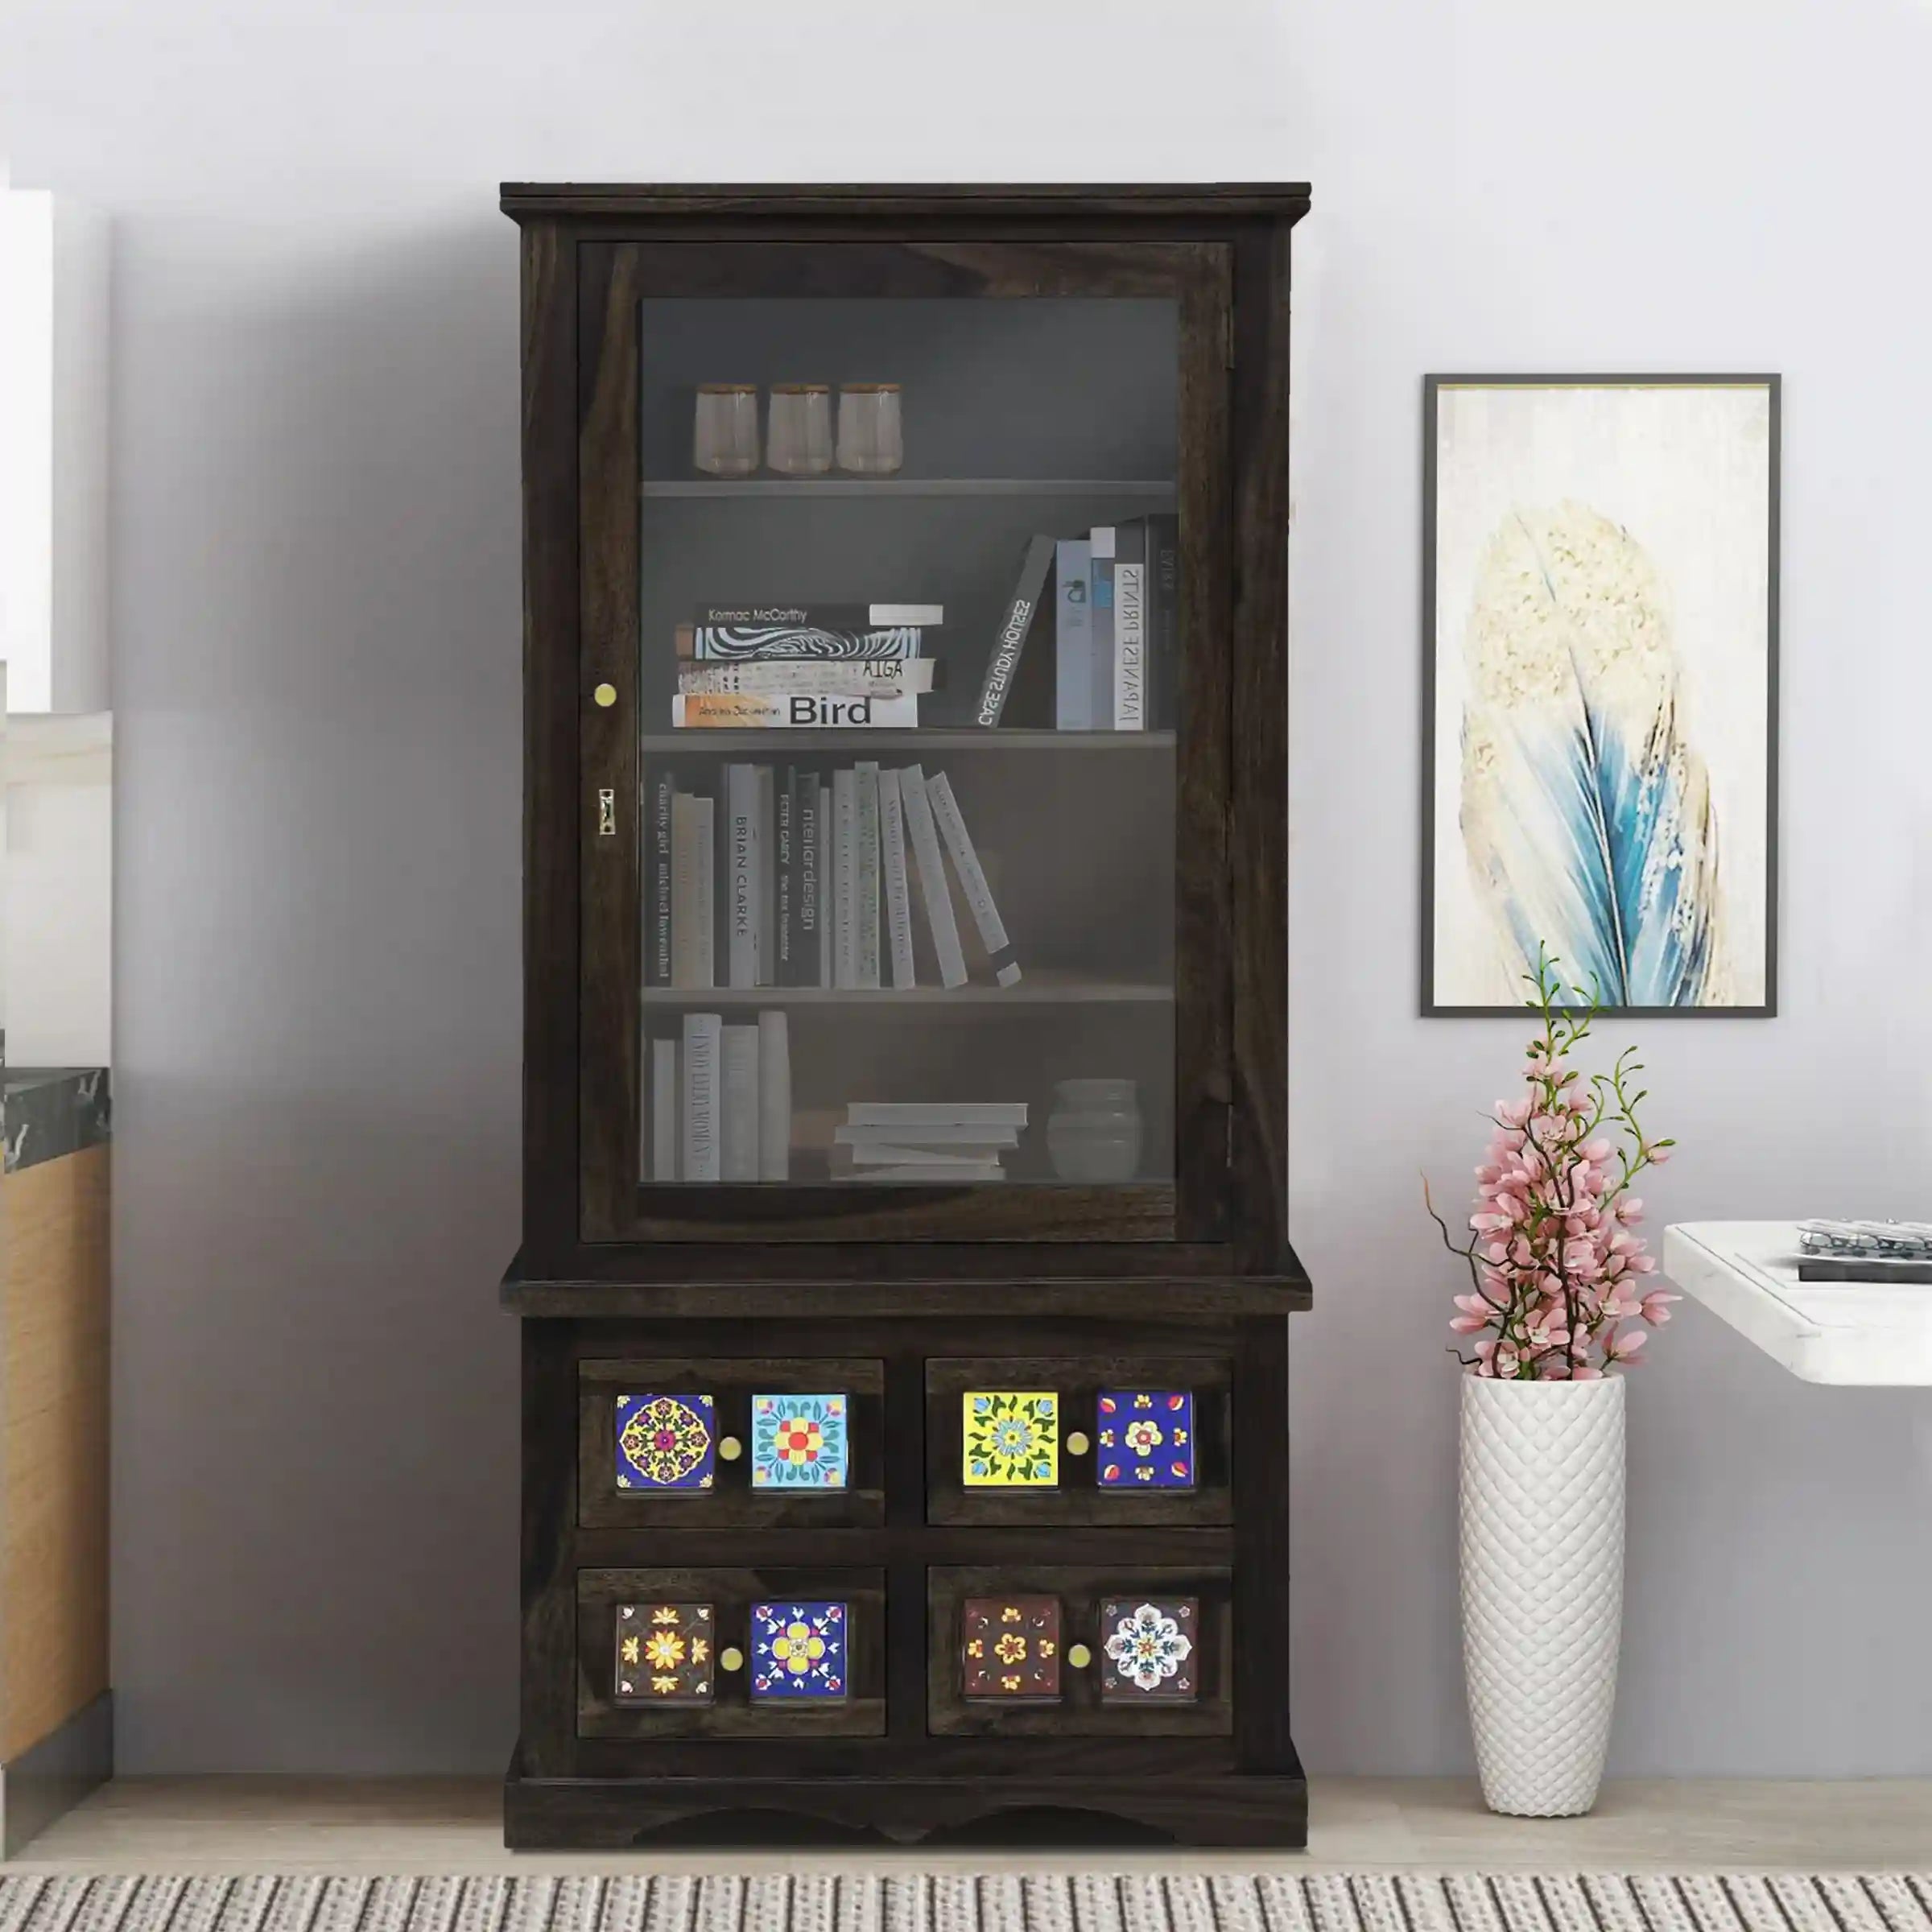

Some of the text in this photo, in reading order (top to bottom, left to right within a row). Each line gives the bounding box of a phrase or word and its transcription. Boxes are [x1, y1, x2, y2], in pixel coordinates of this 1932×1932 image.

[862, 659, 903, 680] AIGA
[790, 696, 871, 724] Bird
[736, 816, 747, 937] BRIAN CLARKE
